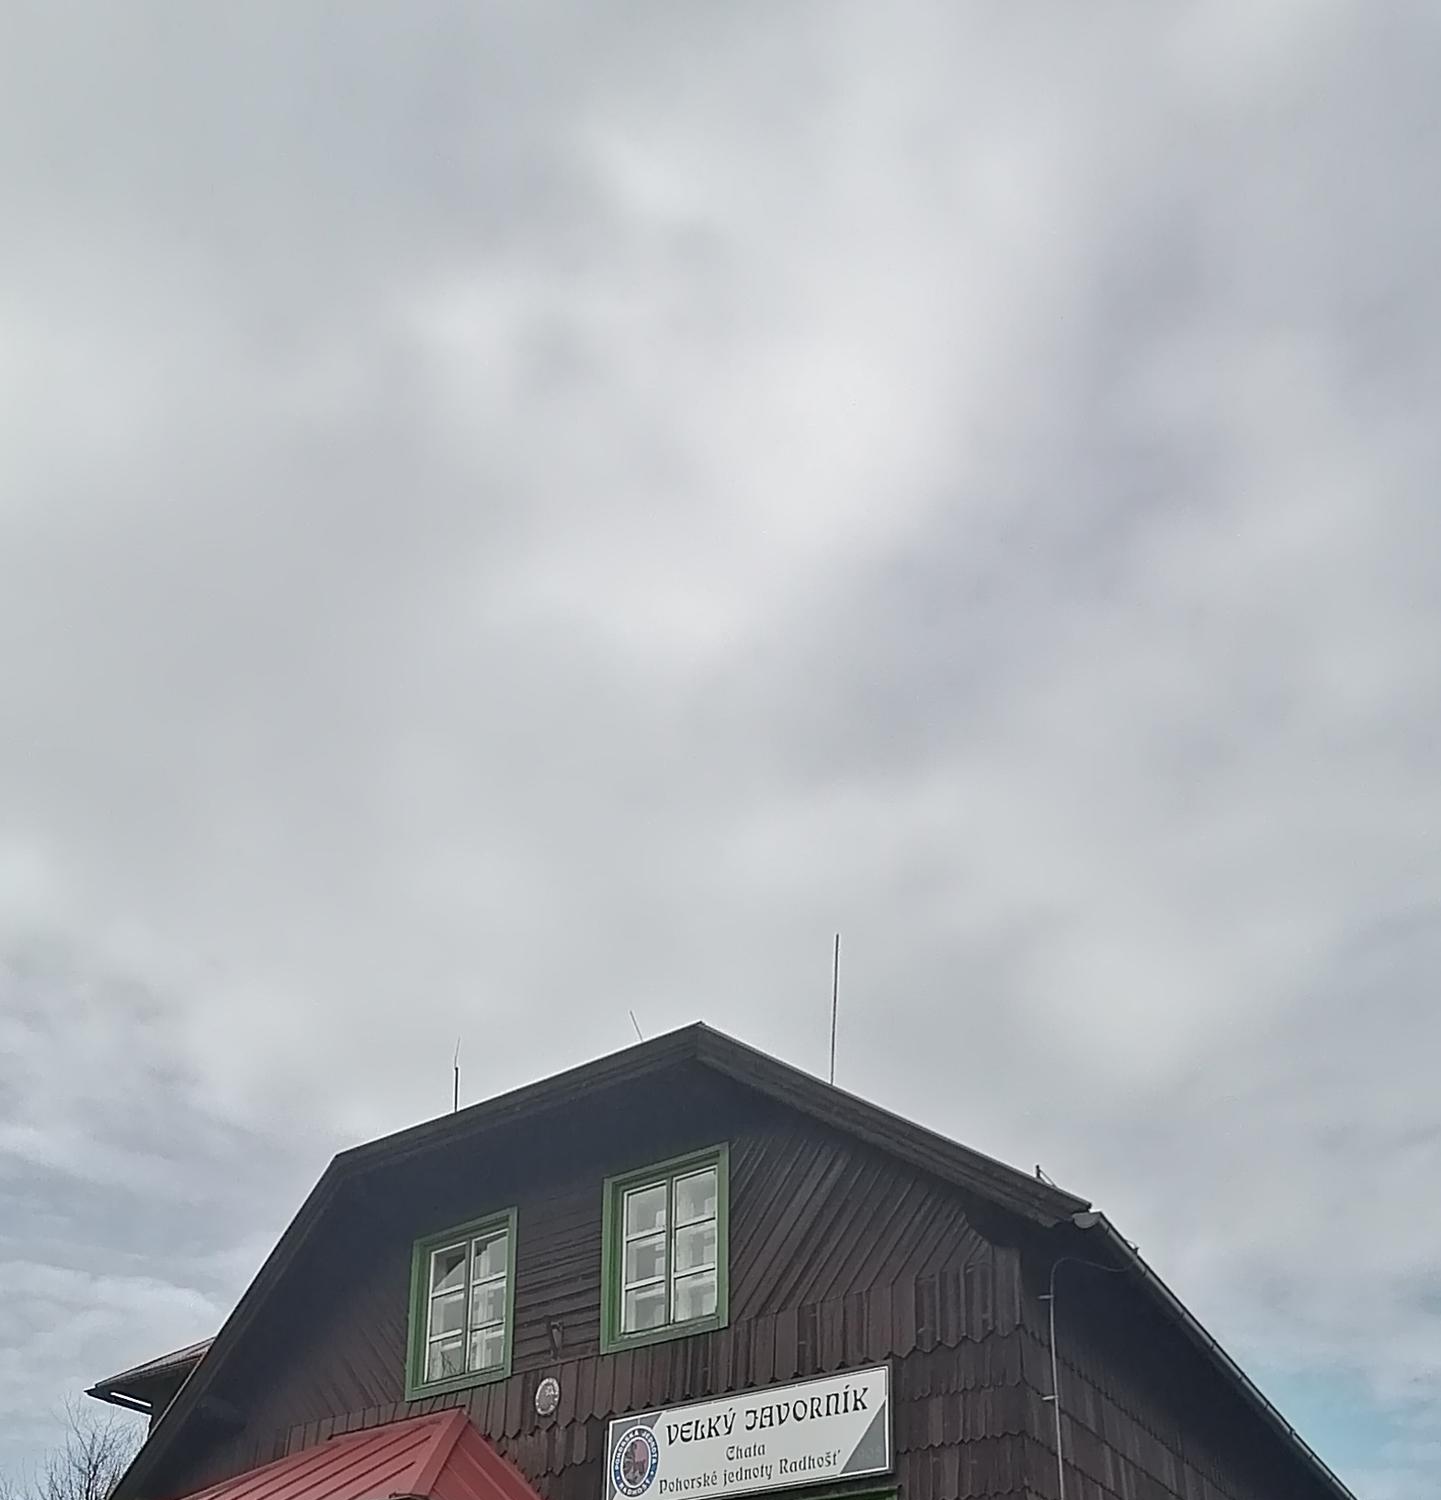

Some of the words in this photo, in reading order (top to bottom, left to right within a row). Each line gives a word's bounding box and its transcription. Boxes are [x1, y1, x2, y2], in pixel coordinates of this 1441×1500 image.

[666, 1407, 736, 1445] VELKÝ
[745, 1384, 868, 1430] JAVORNÍK
[659, 1471, 717, 1494] Pohorské
[723, 1464, 773, 1488] jednoty
[780, 1449, 841, 1474] Radhošť
[726, 1442, 765, 1460] Chata
